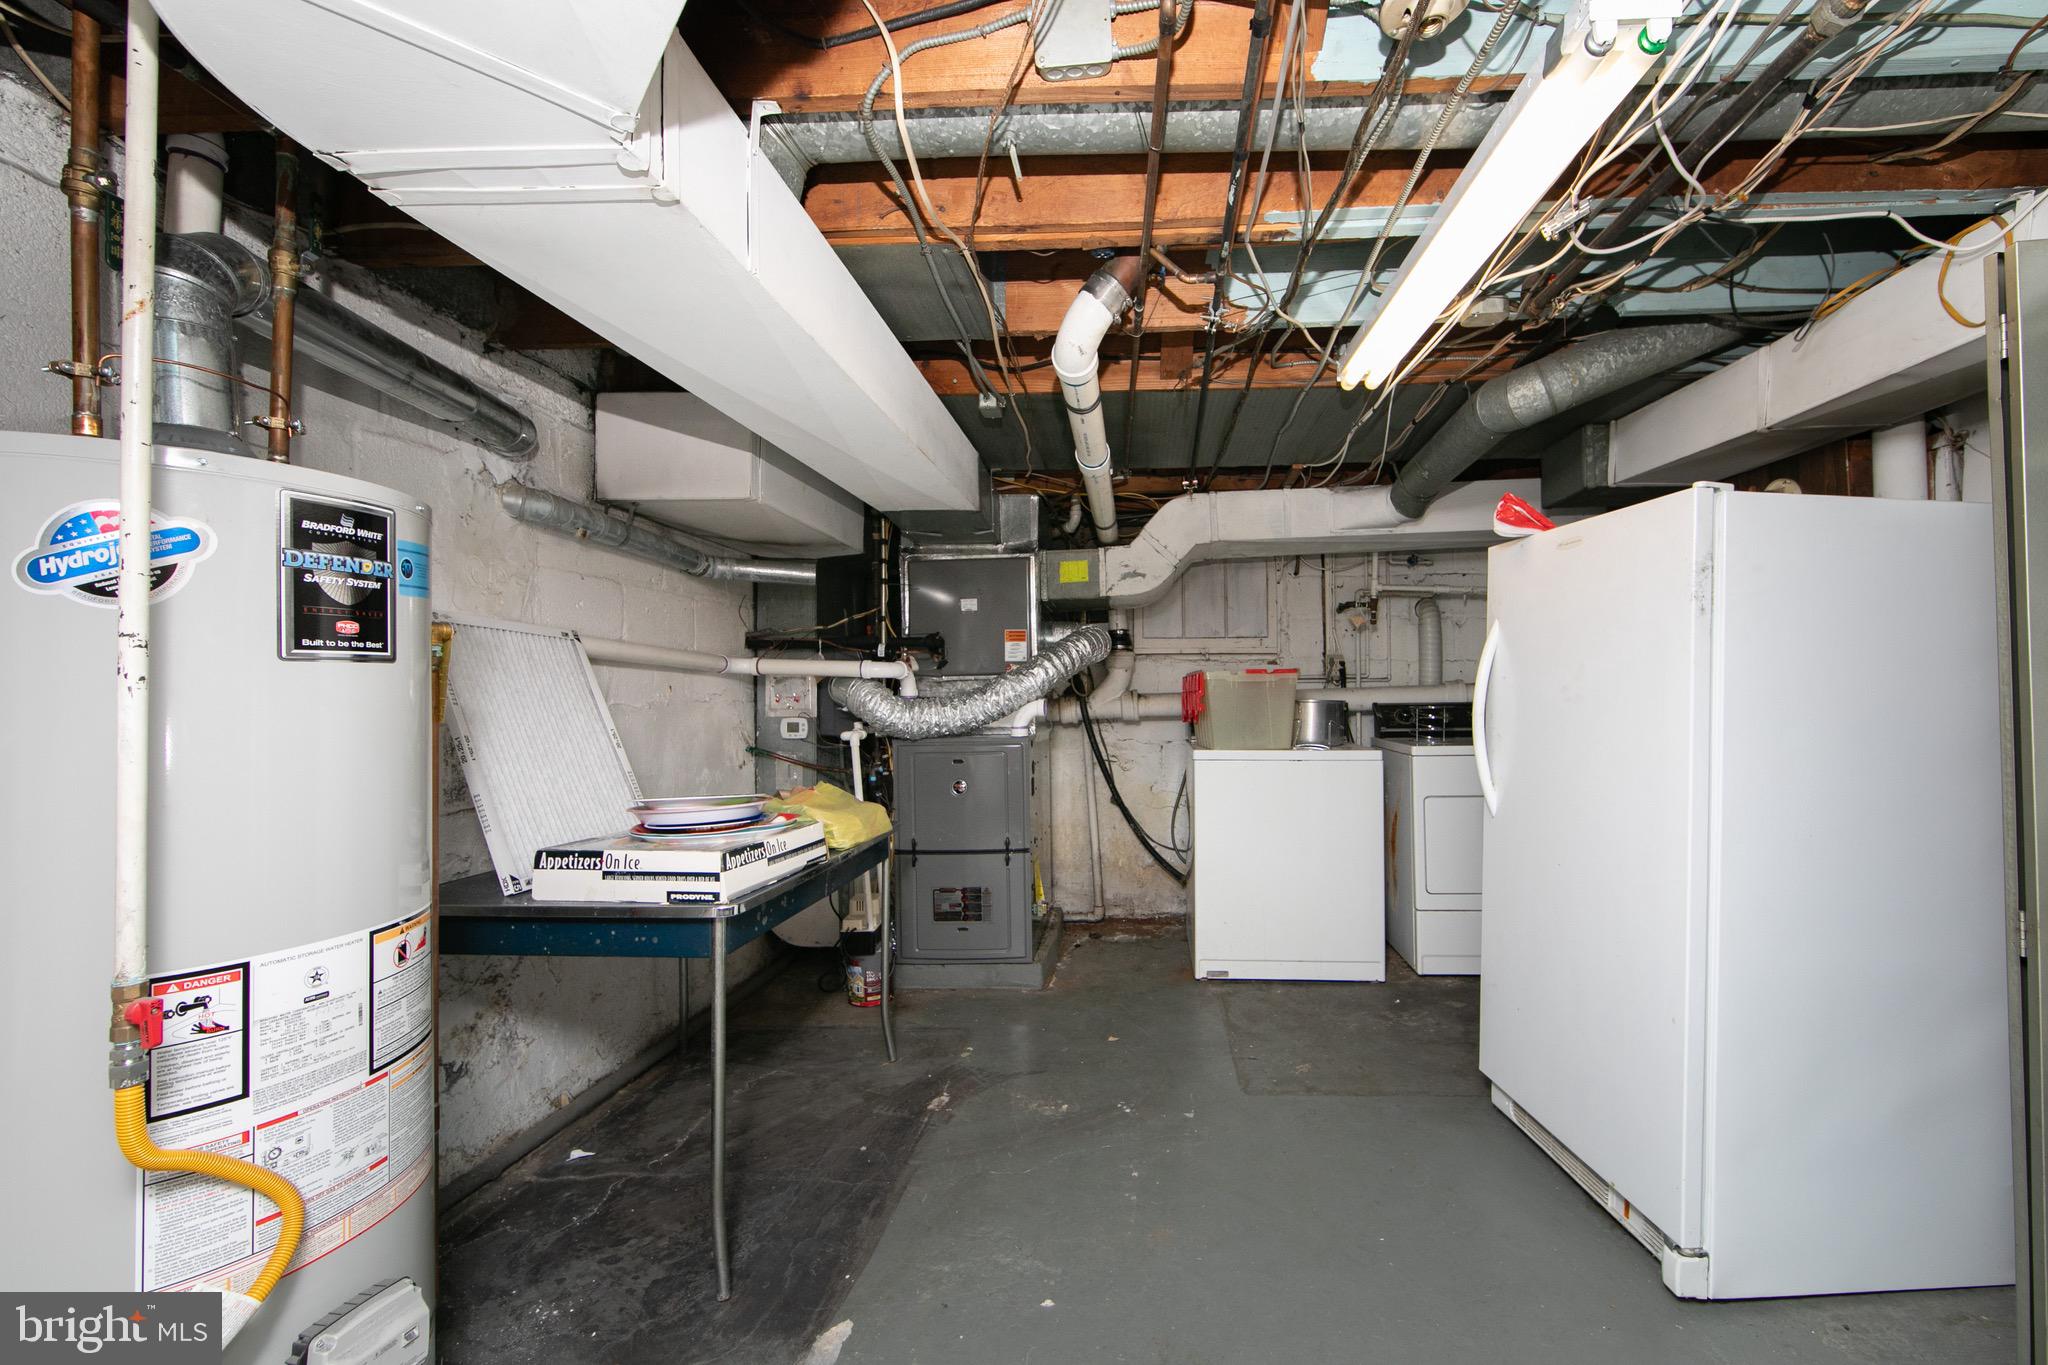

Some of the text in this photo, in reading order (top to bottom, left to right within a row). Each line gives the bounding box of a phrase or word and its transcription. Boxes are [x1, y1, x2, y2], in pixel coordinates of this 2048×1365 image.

[302, 520, 384, 541] BRADFORD WHITE
[150, 533, 192, 547] ERFORMANCE
[150, 544, 173, 553] YSTEM
[39, 541, 120, 577] Hydroj
[282, 547, 394, 579] DEFENDER
[304, 573, 382, 590] SAFETY SYSTEM
[302, 638, 383, 649] Built to be the Best
[539, 852, 640, 870] Appetizers On Ice
[725, 846, 766, 871] Appetizers
[766, 841, 776, 856] On
[777, 838, 787, 851] Ice
[670, 893, 715, 901] PRODYNE.
[259, 937, 363, 968] AUTOMATIC STORAGE WATER HEATER
[183, 974, 232, 989] DANGER
[198, 1011, 216, 1020] HOT
[205, 1139, 229, 1150] SAFETY
